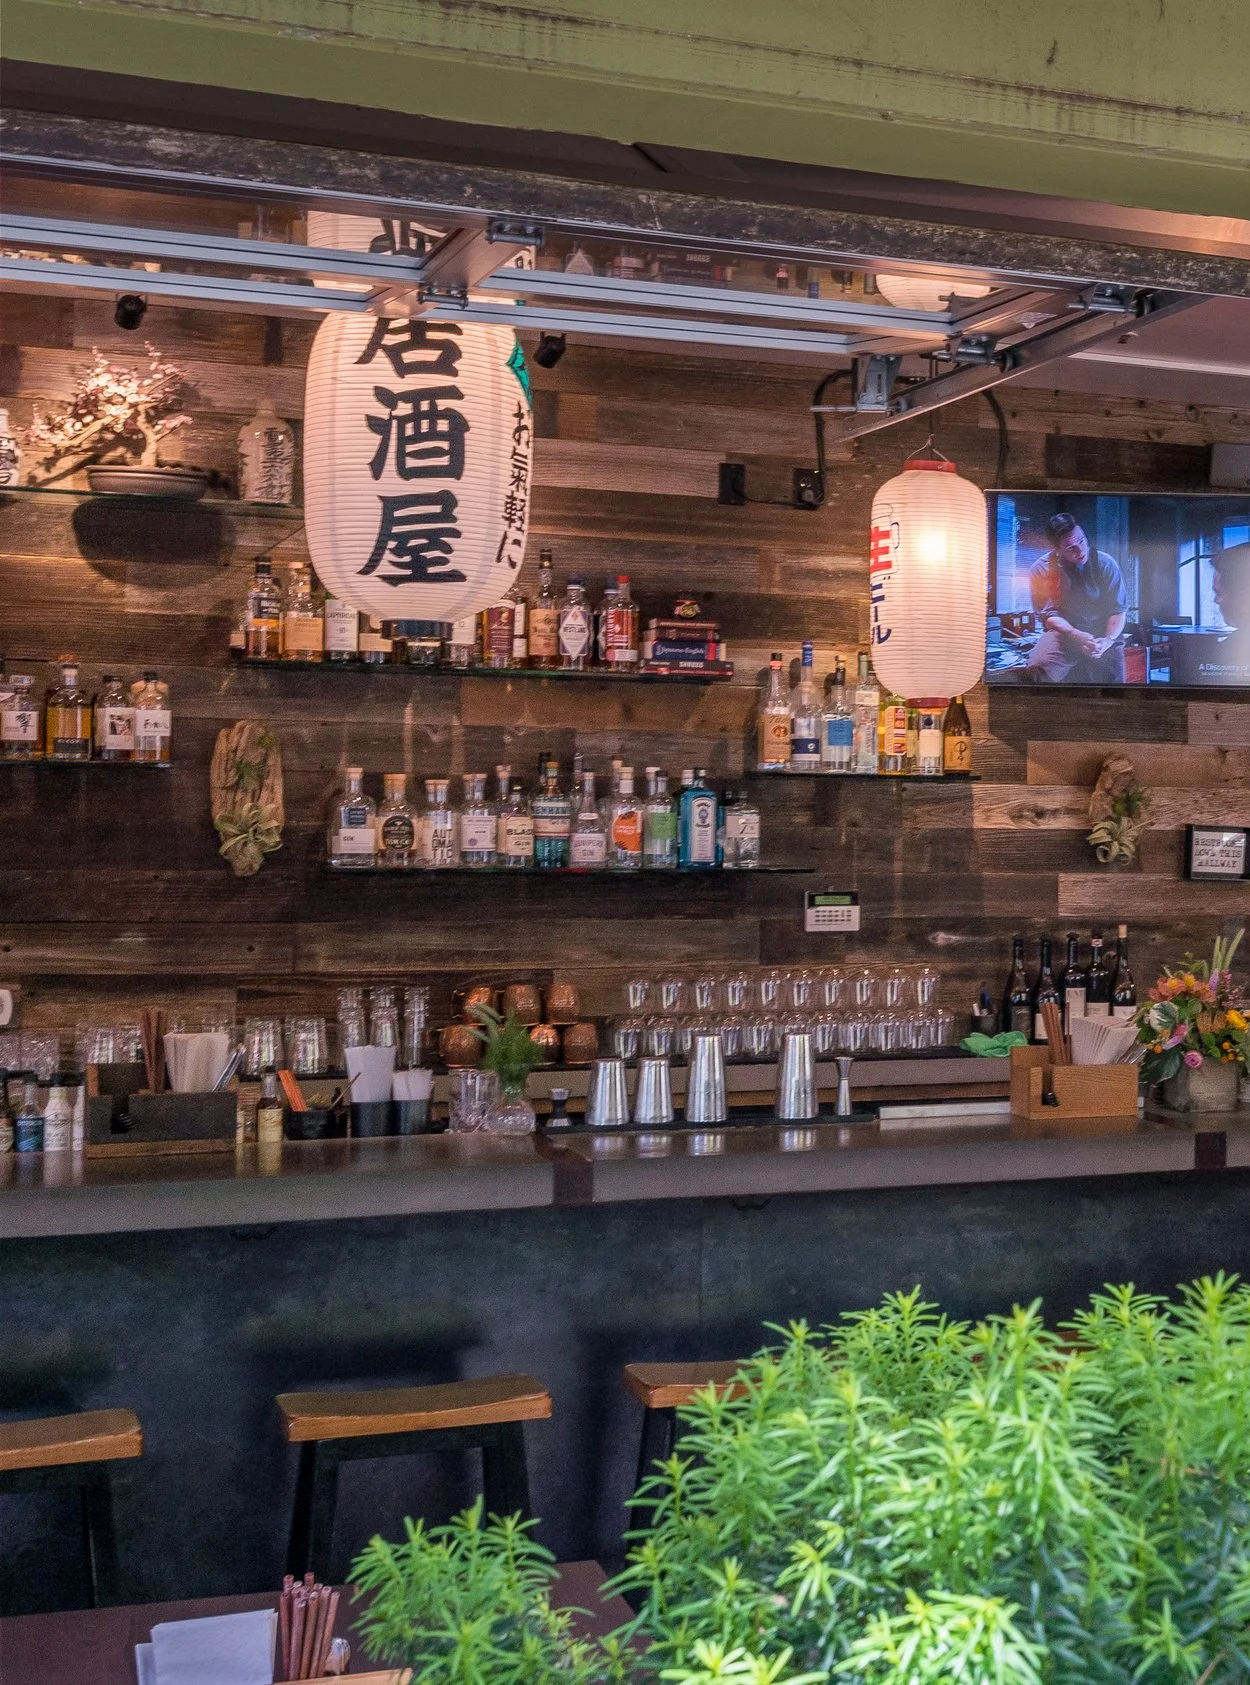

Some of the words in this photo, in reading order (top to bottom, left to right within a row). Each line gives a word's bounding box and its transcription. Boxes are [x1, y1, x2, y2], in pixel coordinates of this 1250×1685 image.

[353, 317, 470, 586] 居酒屋
[1205, 663, 1239, 673] Discovery
[1219, 849, 1242, 858] THIS
[1197, 859, 1237, 868] HALLWAY
